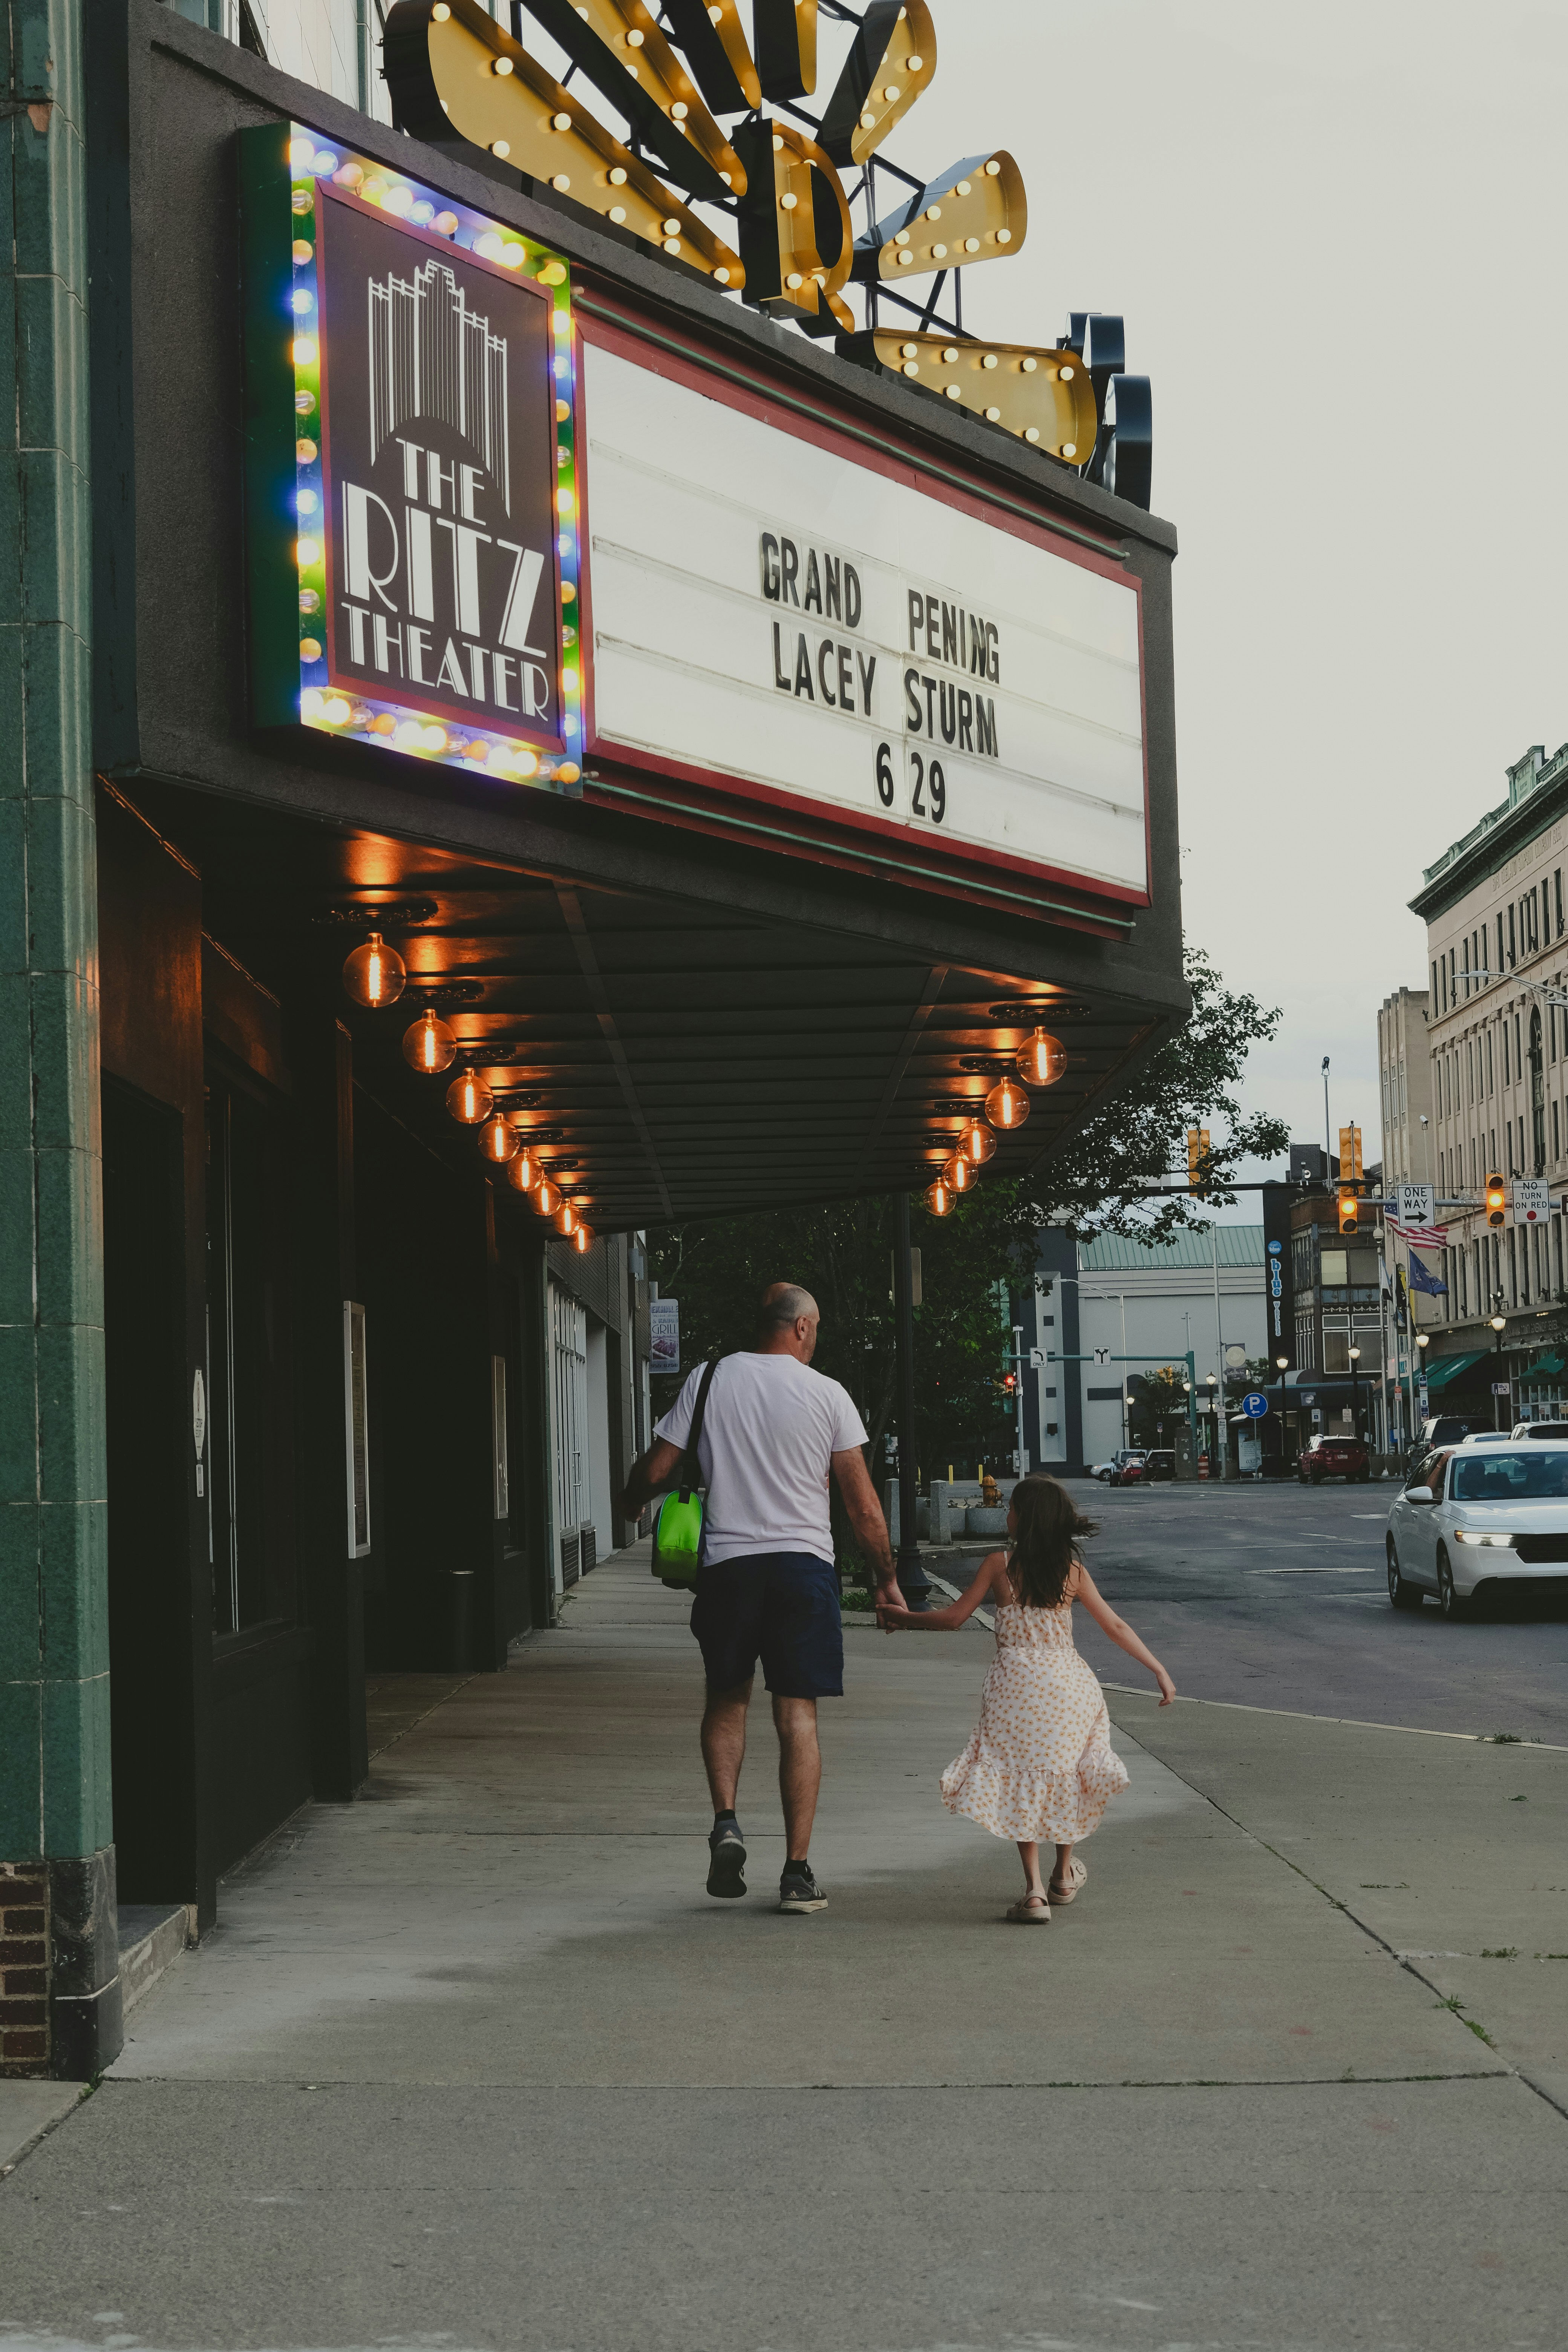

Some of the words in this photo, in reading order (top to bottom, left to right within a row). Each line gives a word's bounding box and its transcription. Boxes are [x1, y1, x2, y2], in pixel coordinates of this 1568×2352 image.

[396, 438, 485, 526] THE
[342, 480, 547, 658] RITZ
[761, 531, 862, 629] GRAND
[908, 588, 1000, 684] PENING
[341, 602, 549, 721] THEATER
[773, 621, 877, 717] LACEY
[905, 669, 998, 758] STURM
[876, 743, 894, 807] 6
[911, 752, 946, 823] 29
[1404, 1187, 1427, 1197] ONE
[1404, 1199, 1428, 1209] WAY
[1523, 1182, 1537, 1190] NO
[1271, 1259, 1282, 1297] blue
[652, 1324, 678, 1334] GRILL
[1249, 1396, 1260, 1410] P
